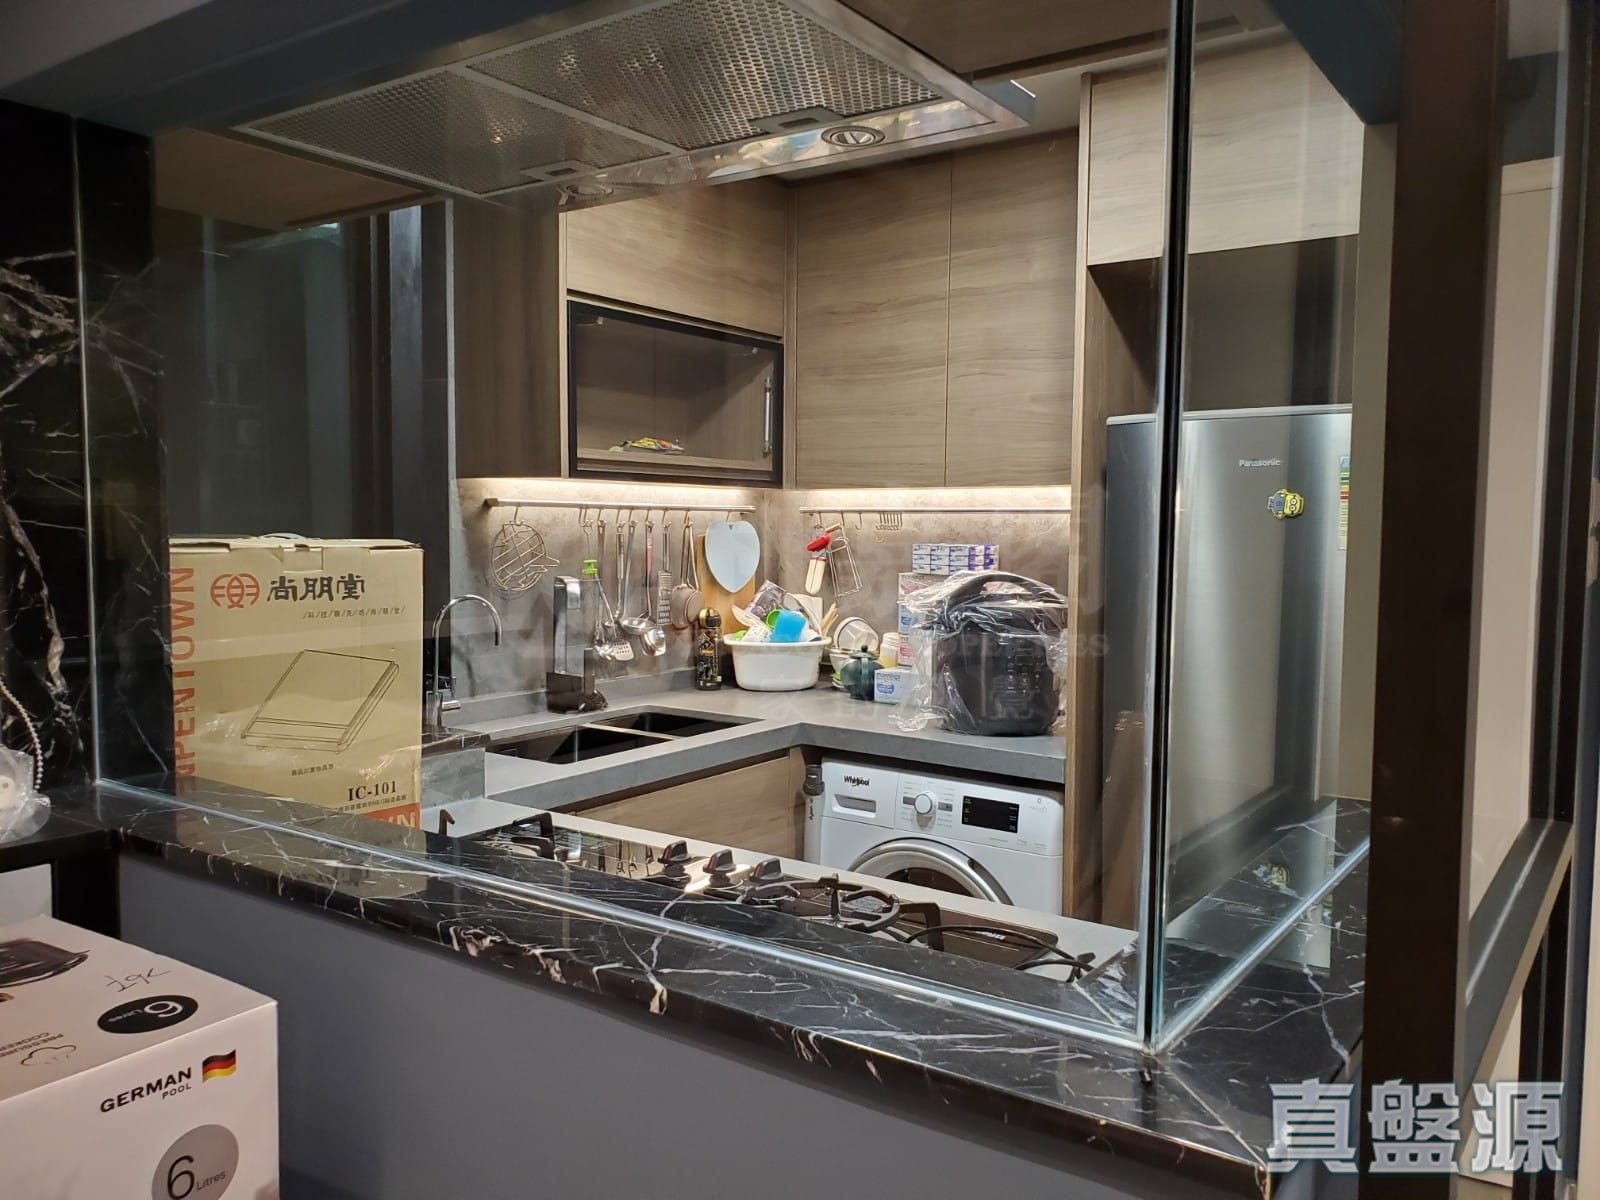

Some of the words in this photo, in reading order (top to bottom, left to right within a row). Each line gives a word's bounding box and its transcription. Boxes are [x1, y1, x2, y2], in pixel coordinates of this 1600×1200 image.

[1238, 458, 1281, 467] Panasonic
[266, 573, 366, 602] 尚朋堂
[347, 780, 398, 802] IC-101
[99, 1066, 192, 1113] GERMAN
[162, 1082, 192, 1100] POOL
[166, 1154, 196, 1200] 6
[195, 1170, 227, 1190] Litres
